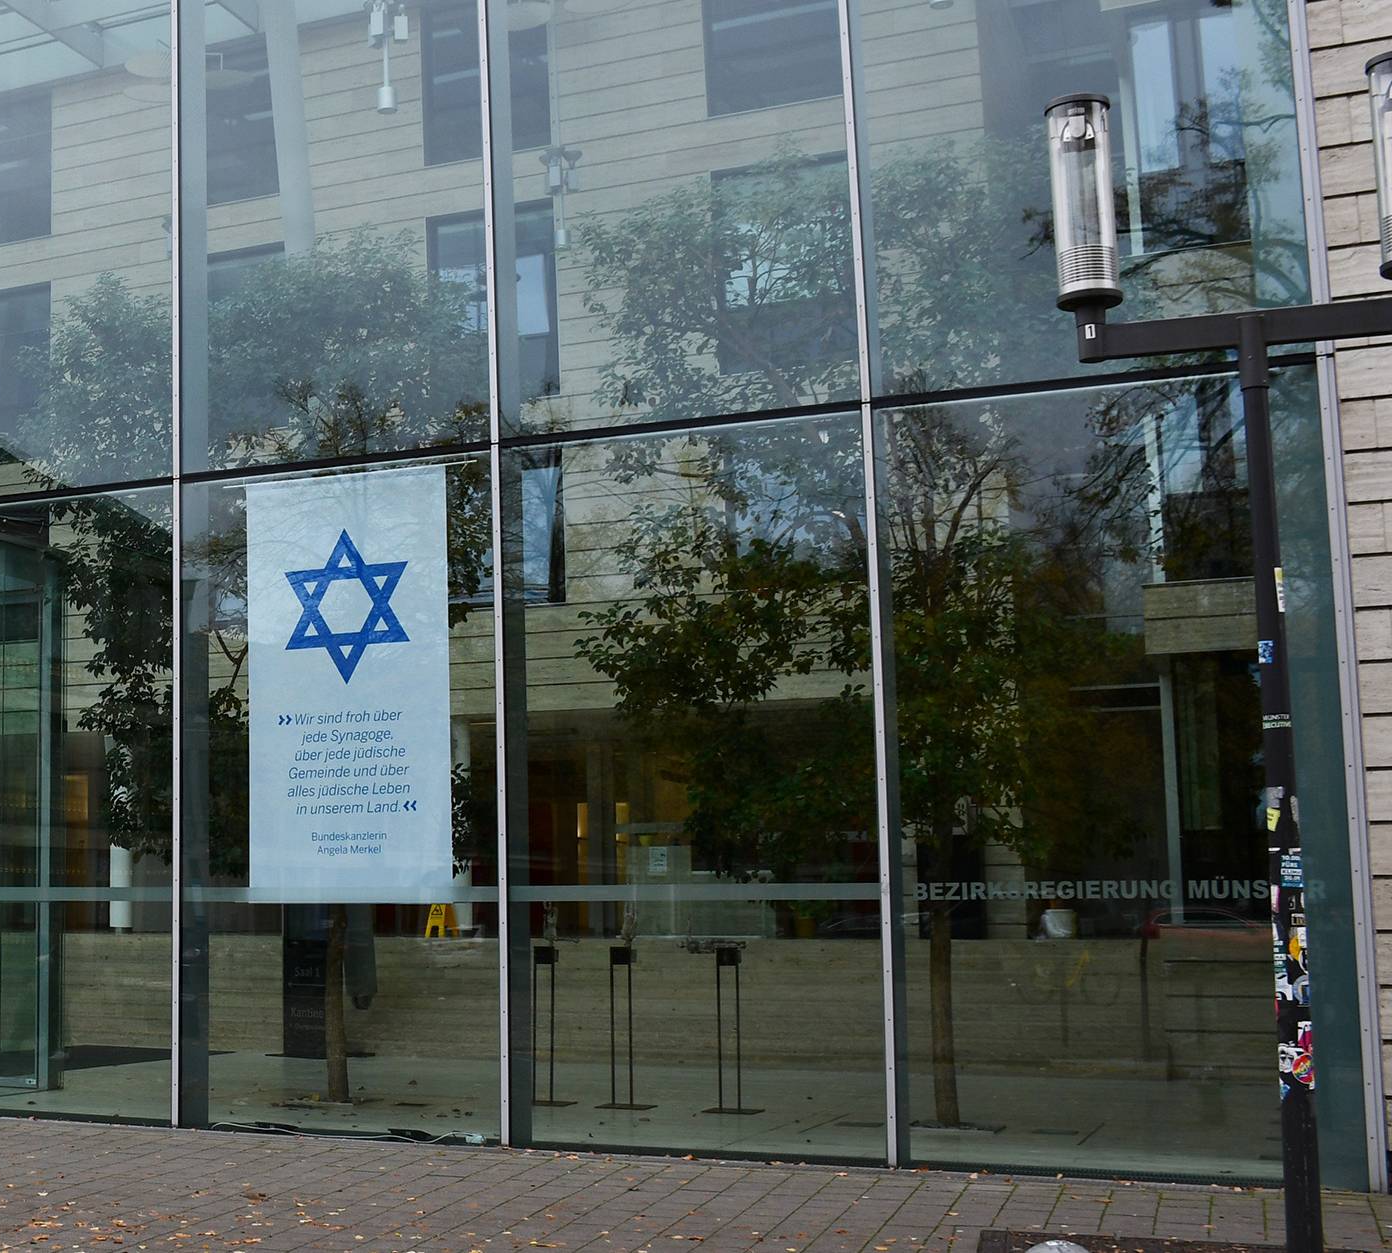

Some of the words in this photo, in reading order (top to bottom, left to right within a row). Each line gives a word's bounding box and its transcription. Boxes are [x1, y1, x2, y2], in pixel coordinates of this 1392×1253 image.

[316, 711, 343, 724] sind
[345, 711, 371, 722] froh
[373, 709, 403, 722] über
[301, 730, 328, 746] jede
[294, 750, 321, 762] über
[324, 748, 350, 763] jede
[353, 746, 406, 761] jüdische
[288, 766, 350, 779] Gemeinde
[353, 765, 377, 777] und
[380, 764, 410, 776] über
[287, 785, 315, 798] alles
[317, 784, 369, 799] jüdische
[372, 782, 410, 795] Leben
[296, 803, 307, 815] in
[310, 803, 363, 815] unserem
[311, 831, 387, 842] Bundeskanzlerin
[317, 845, 348, 856] Angela
[350, 844, 381, 854] Merkel
[912, 880, 1177, 901] BEZIRKSREGIERUNG
[1188, 876, 1326, 900] MÜNSR
